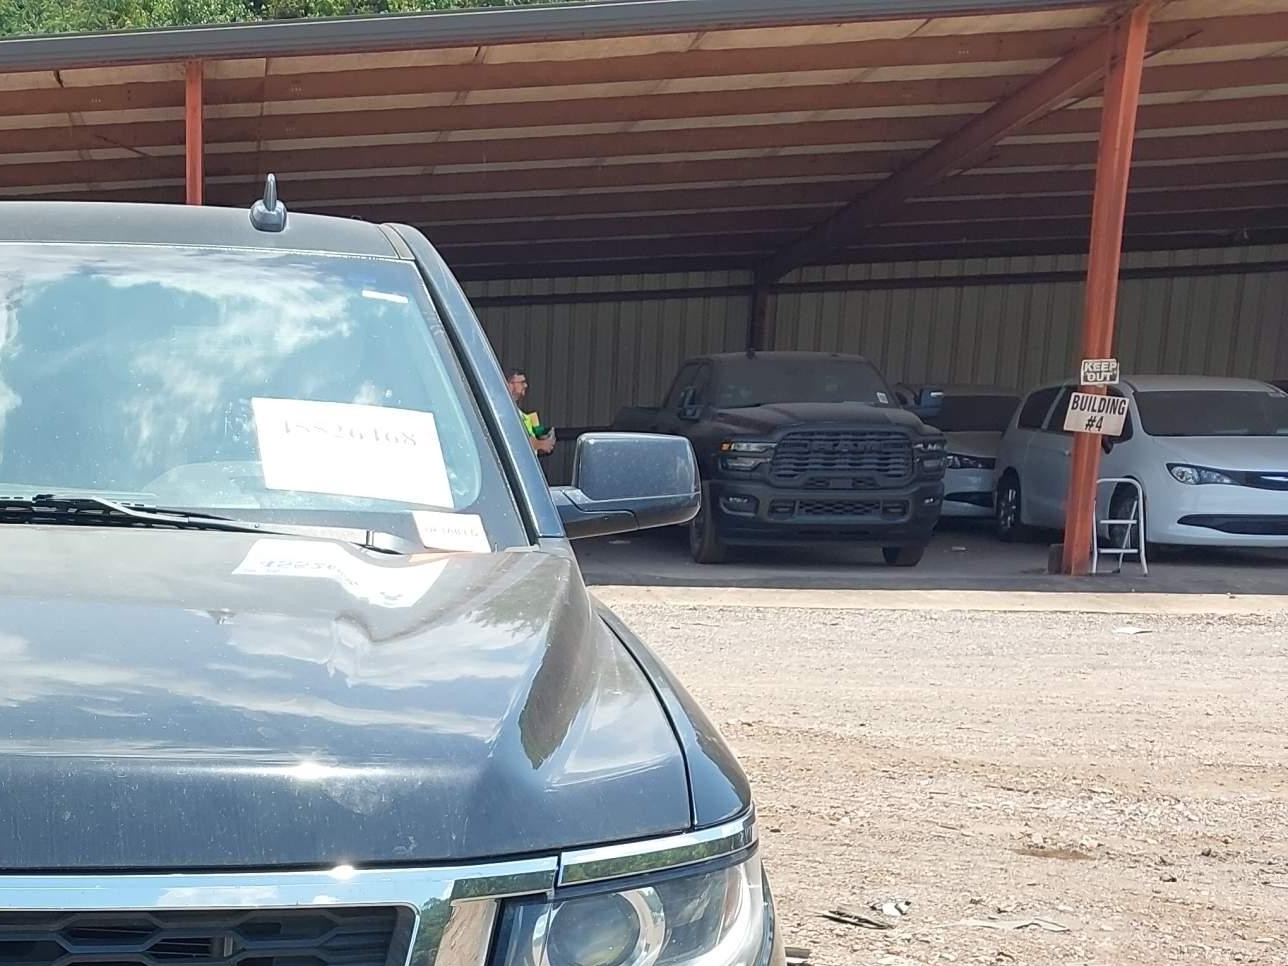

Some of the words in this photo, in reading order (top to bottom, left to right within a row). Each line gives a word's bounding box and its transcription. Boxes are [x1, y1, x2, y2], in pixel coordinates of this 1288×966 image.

[1084, 361, 1117, 372] KEEP
[1087, 372, 1113, 382] OUT
[1070, 394, 1127, 416] BUILDING
[1084, 415, 1104, 432] #4
